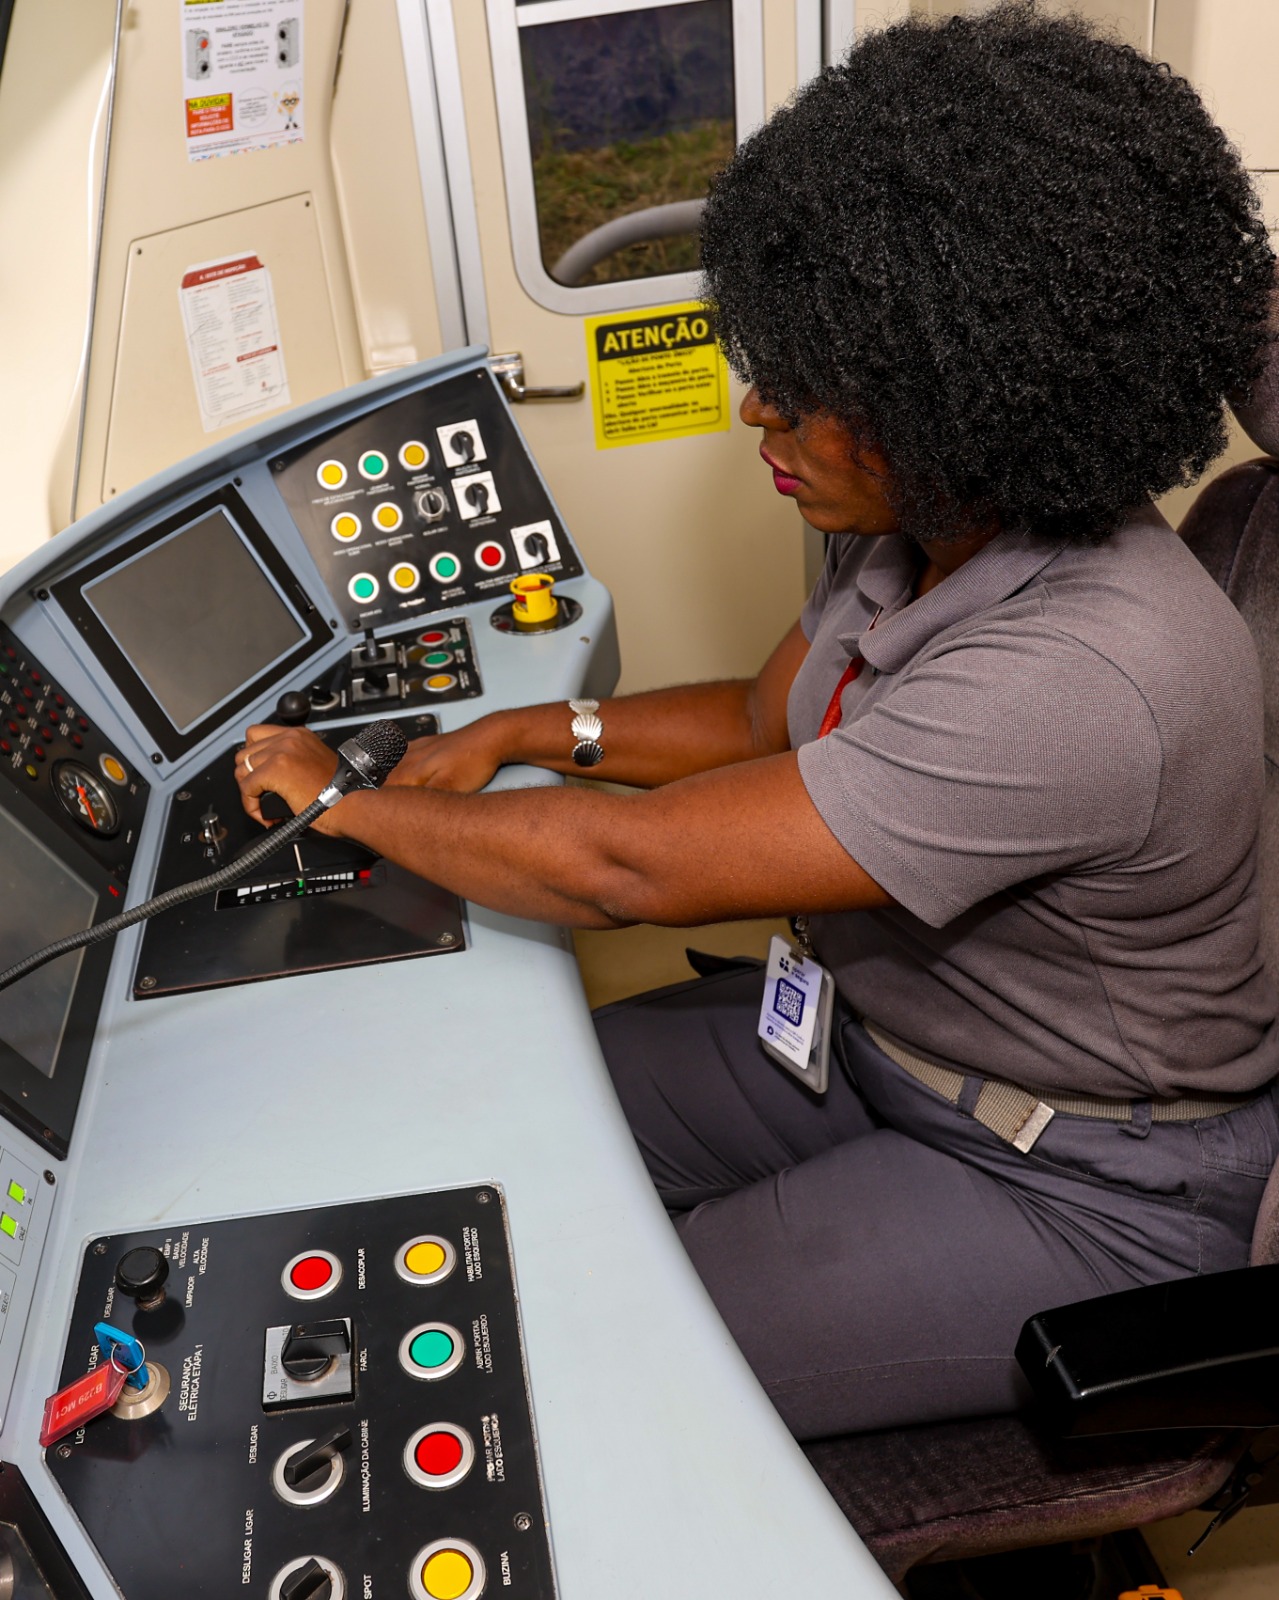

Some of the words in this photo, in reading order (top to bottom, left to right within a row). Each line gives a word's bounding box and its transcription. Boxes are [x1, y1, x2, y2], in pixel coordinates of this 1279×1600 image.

[604, 317, 709, 353] ATENÇÃO
[179, 1231, 189, 1269] VELOCIDADE
[463, 1226, 471, 1251] PORTAS
[471, 1228, 481, 1261] ESQUERDO
[199, 1238, 209, 1275] VELOCIDADE
[465, 1251, 475, 1282] HABILITAR
[474, 1262, 482, 1279] LADO
[1, 1293, 10, 1314] SELECT
[104, 1287, 115, 1318] DESLIGAR
[186, 1276, 195, 1308] LIMPADOR
[472, 1320, 481, 1347] PORTAS
[480, 1314, 491, 1353] ESQUERDO
[192, 1350, 202, 1376] ETAPA
[474, 1347, 484, 1369] ABRIR
[484, 1354, 493, 1373] LADO
[179, 1356, 193, 1411] SEGURANÇA
[188, 1377, 200, 1421] ELÉTRICA
[56, 1403, 76, 1420] MC1
[249, 1424, 258, 1464] DESLIGAR
[361, 1419, 369, 1448] CABINE
[362, 1448, 369, 1460] DA
[495, 1459, 505, 1482] LADO
[361, 1461, 371, 1512] ILUMINAÇÃO
[245, 1509, 254, 1535] LIGAR
[242, 1539, 252, 1584] DESLIGAR
[500, 1551, 511, 1586] BUZINA
[363, 1574, 372, 1600] SPOT
